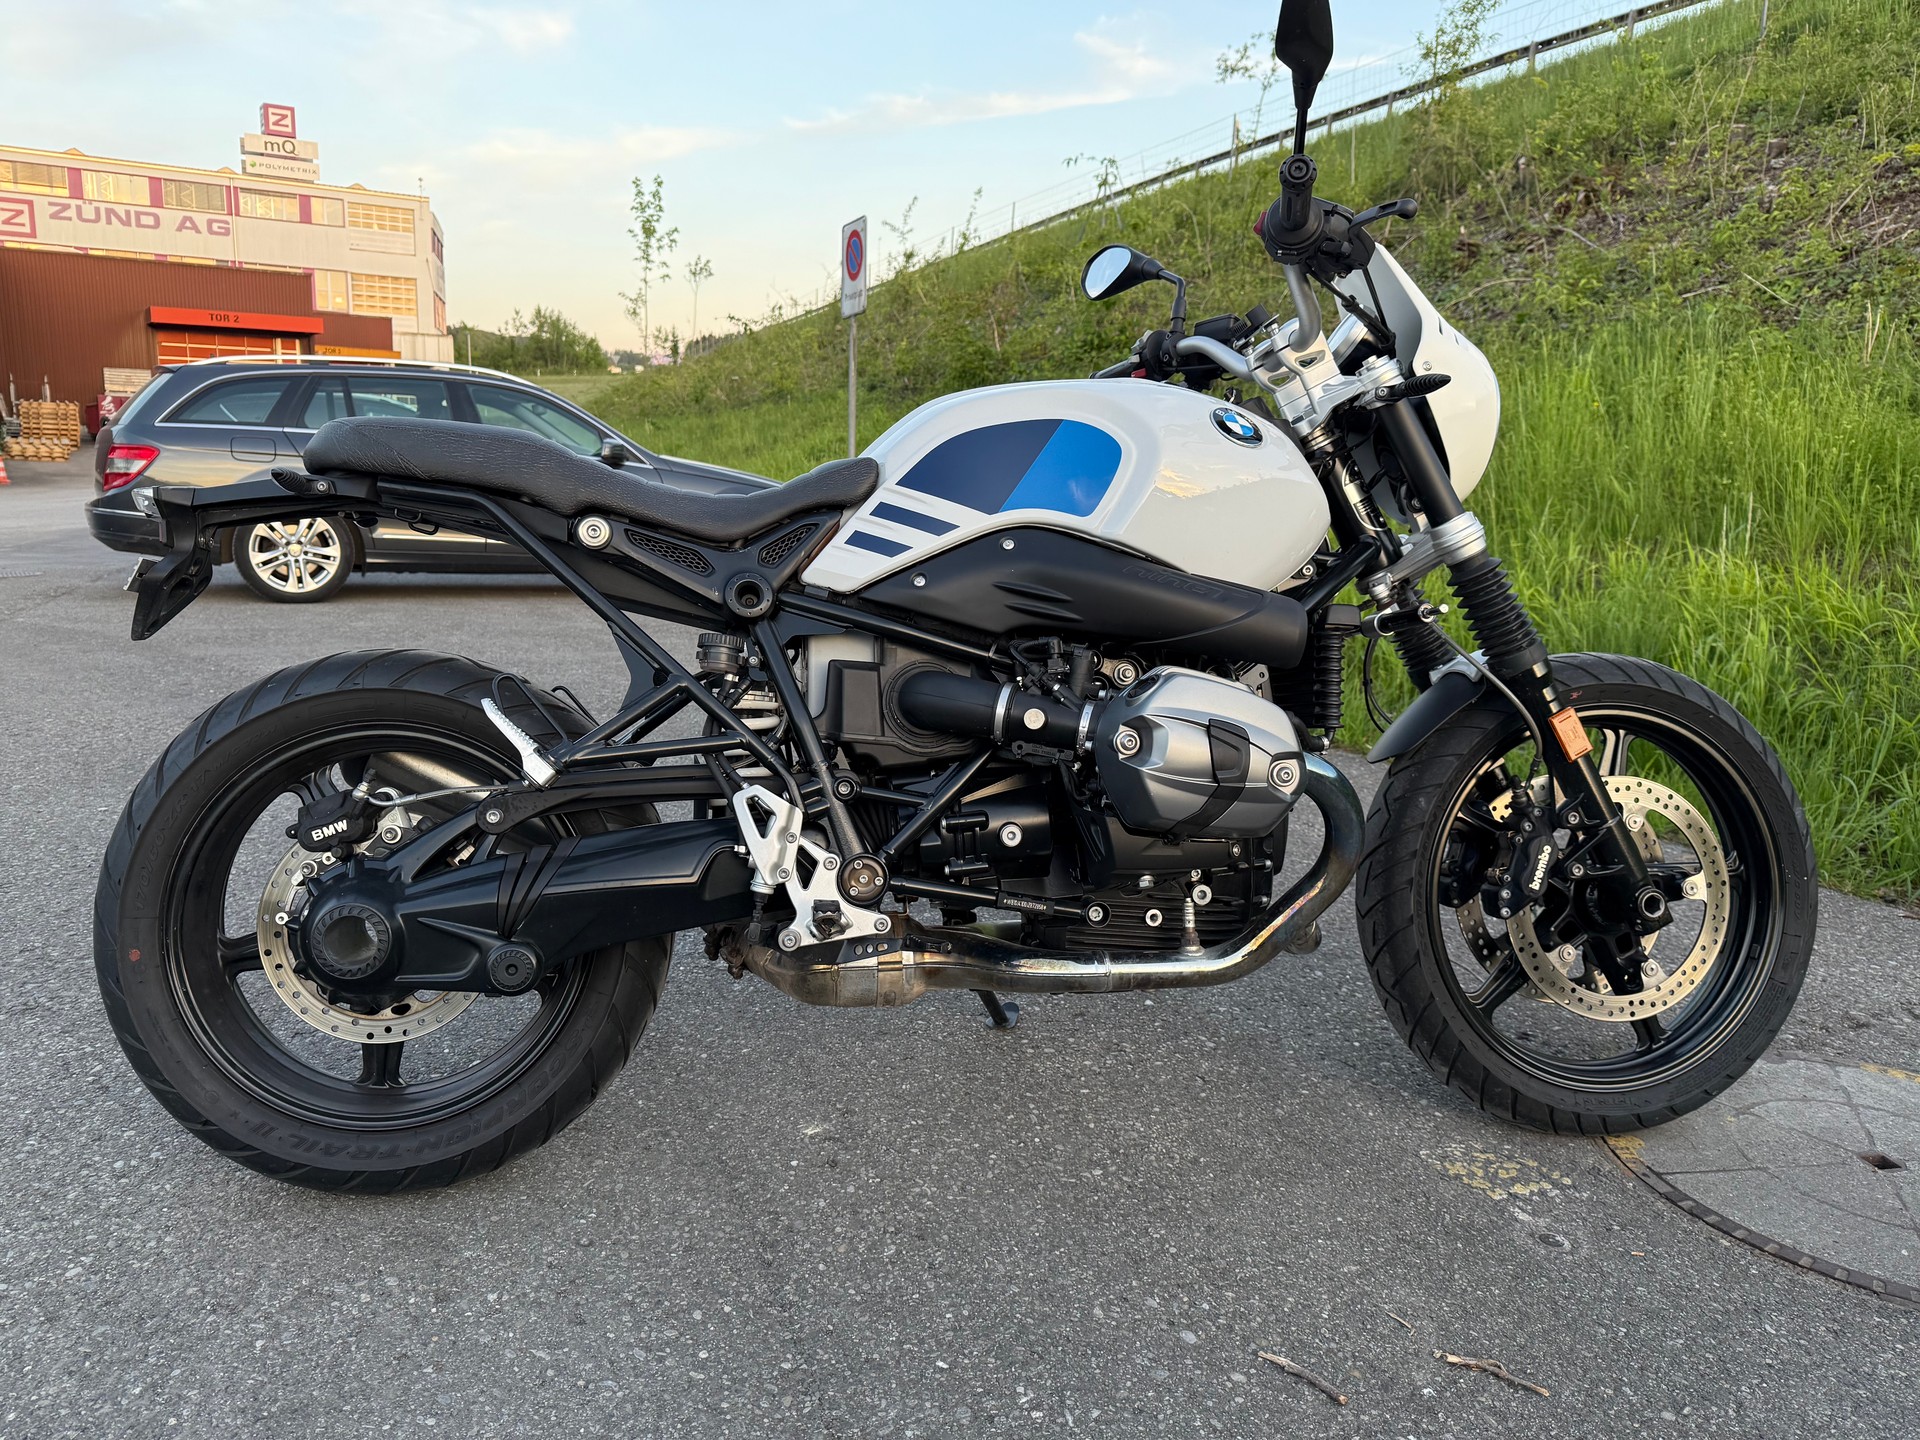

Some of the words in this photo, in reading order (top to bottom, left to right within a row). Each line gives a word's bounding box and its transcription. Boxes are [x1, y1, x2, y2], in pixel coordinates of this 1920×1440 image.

[264, 140, 299, 156] mQ
[259, 162, 317, 175] POLYMETRIX
[48, 201, 161, 230] ZÜND
[175, 215, 231, 237] AG
[208, 312, 230, 323] TOR
[233, 313, 240, 323] 2
[311, 820, 347, 841] BMW
[1529, 845, 1551, 890] brembo
[286, 1132, 402, 1160] TRAIL
